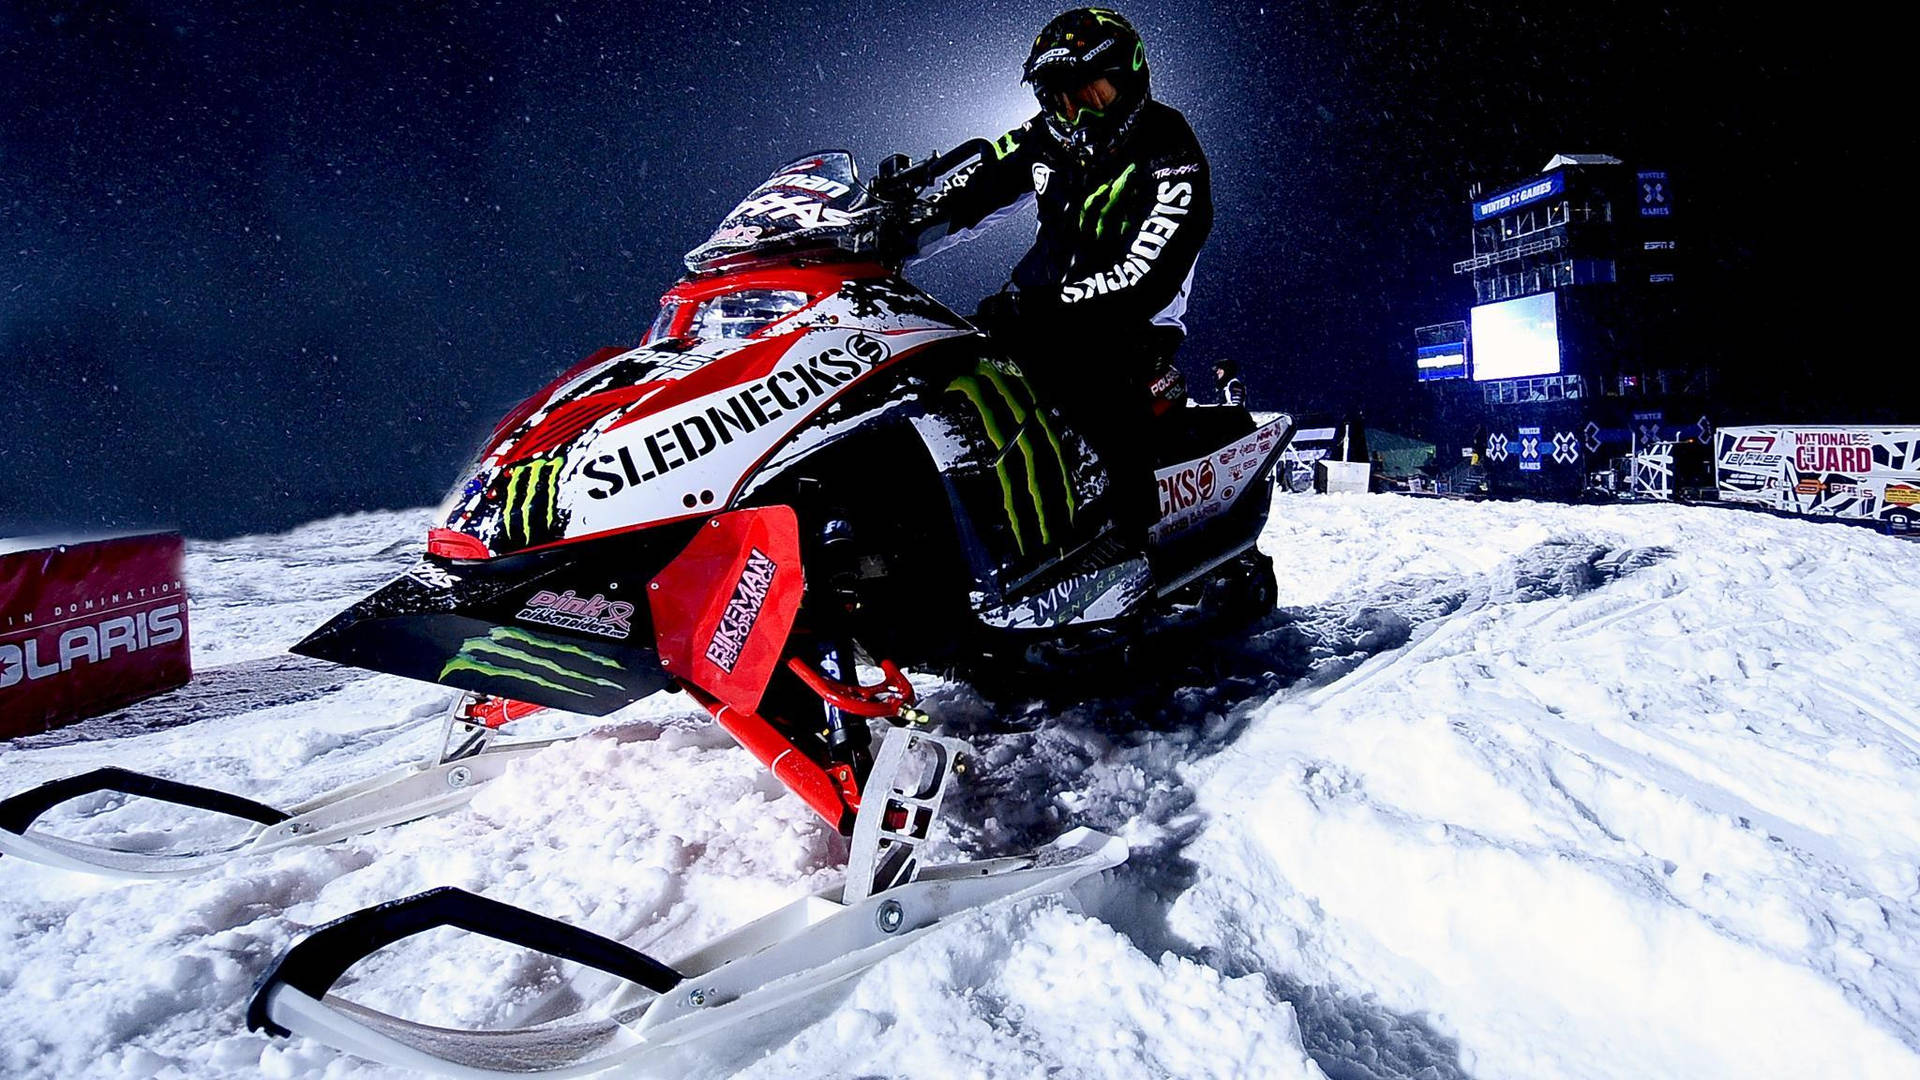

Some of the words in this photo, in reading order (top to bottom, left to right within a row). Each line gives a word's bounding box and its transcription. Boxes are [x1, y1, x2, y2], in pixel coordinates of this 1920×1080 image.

[1480, 198, 1510, 216] WINTER
[1520, 181, 1552, 202] GAMES
[1641, 207, 1670, 216] GAMES
[1649, 273, 1674, 283] ESPN
[582, 348, 862, 499] SLEDNECKS
[1633, 412, 1662, 421] WINTER
[1519, 427, 1541, 435] WINTER
[1795, 433, 1852, 446] NATIONAL
[1519, 461, 1541, 470] GAMES
[1796, 446, 1872, 473] GUARD
[8, 612, 33, 625] IN
[54, 580, 182, 616] DOMINATION
[705, 548, 771, 663] BIKEMAN
[718, 562, 777, 674] PERFORMANCE
[0, 604, 183, 688] OLARIS
